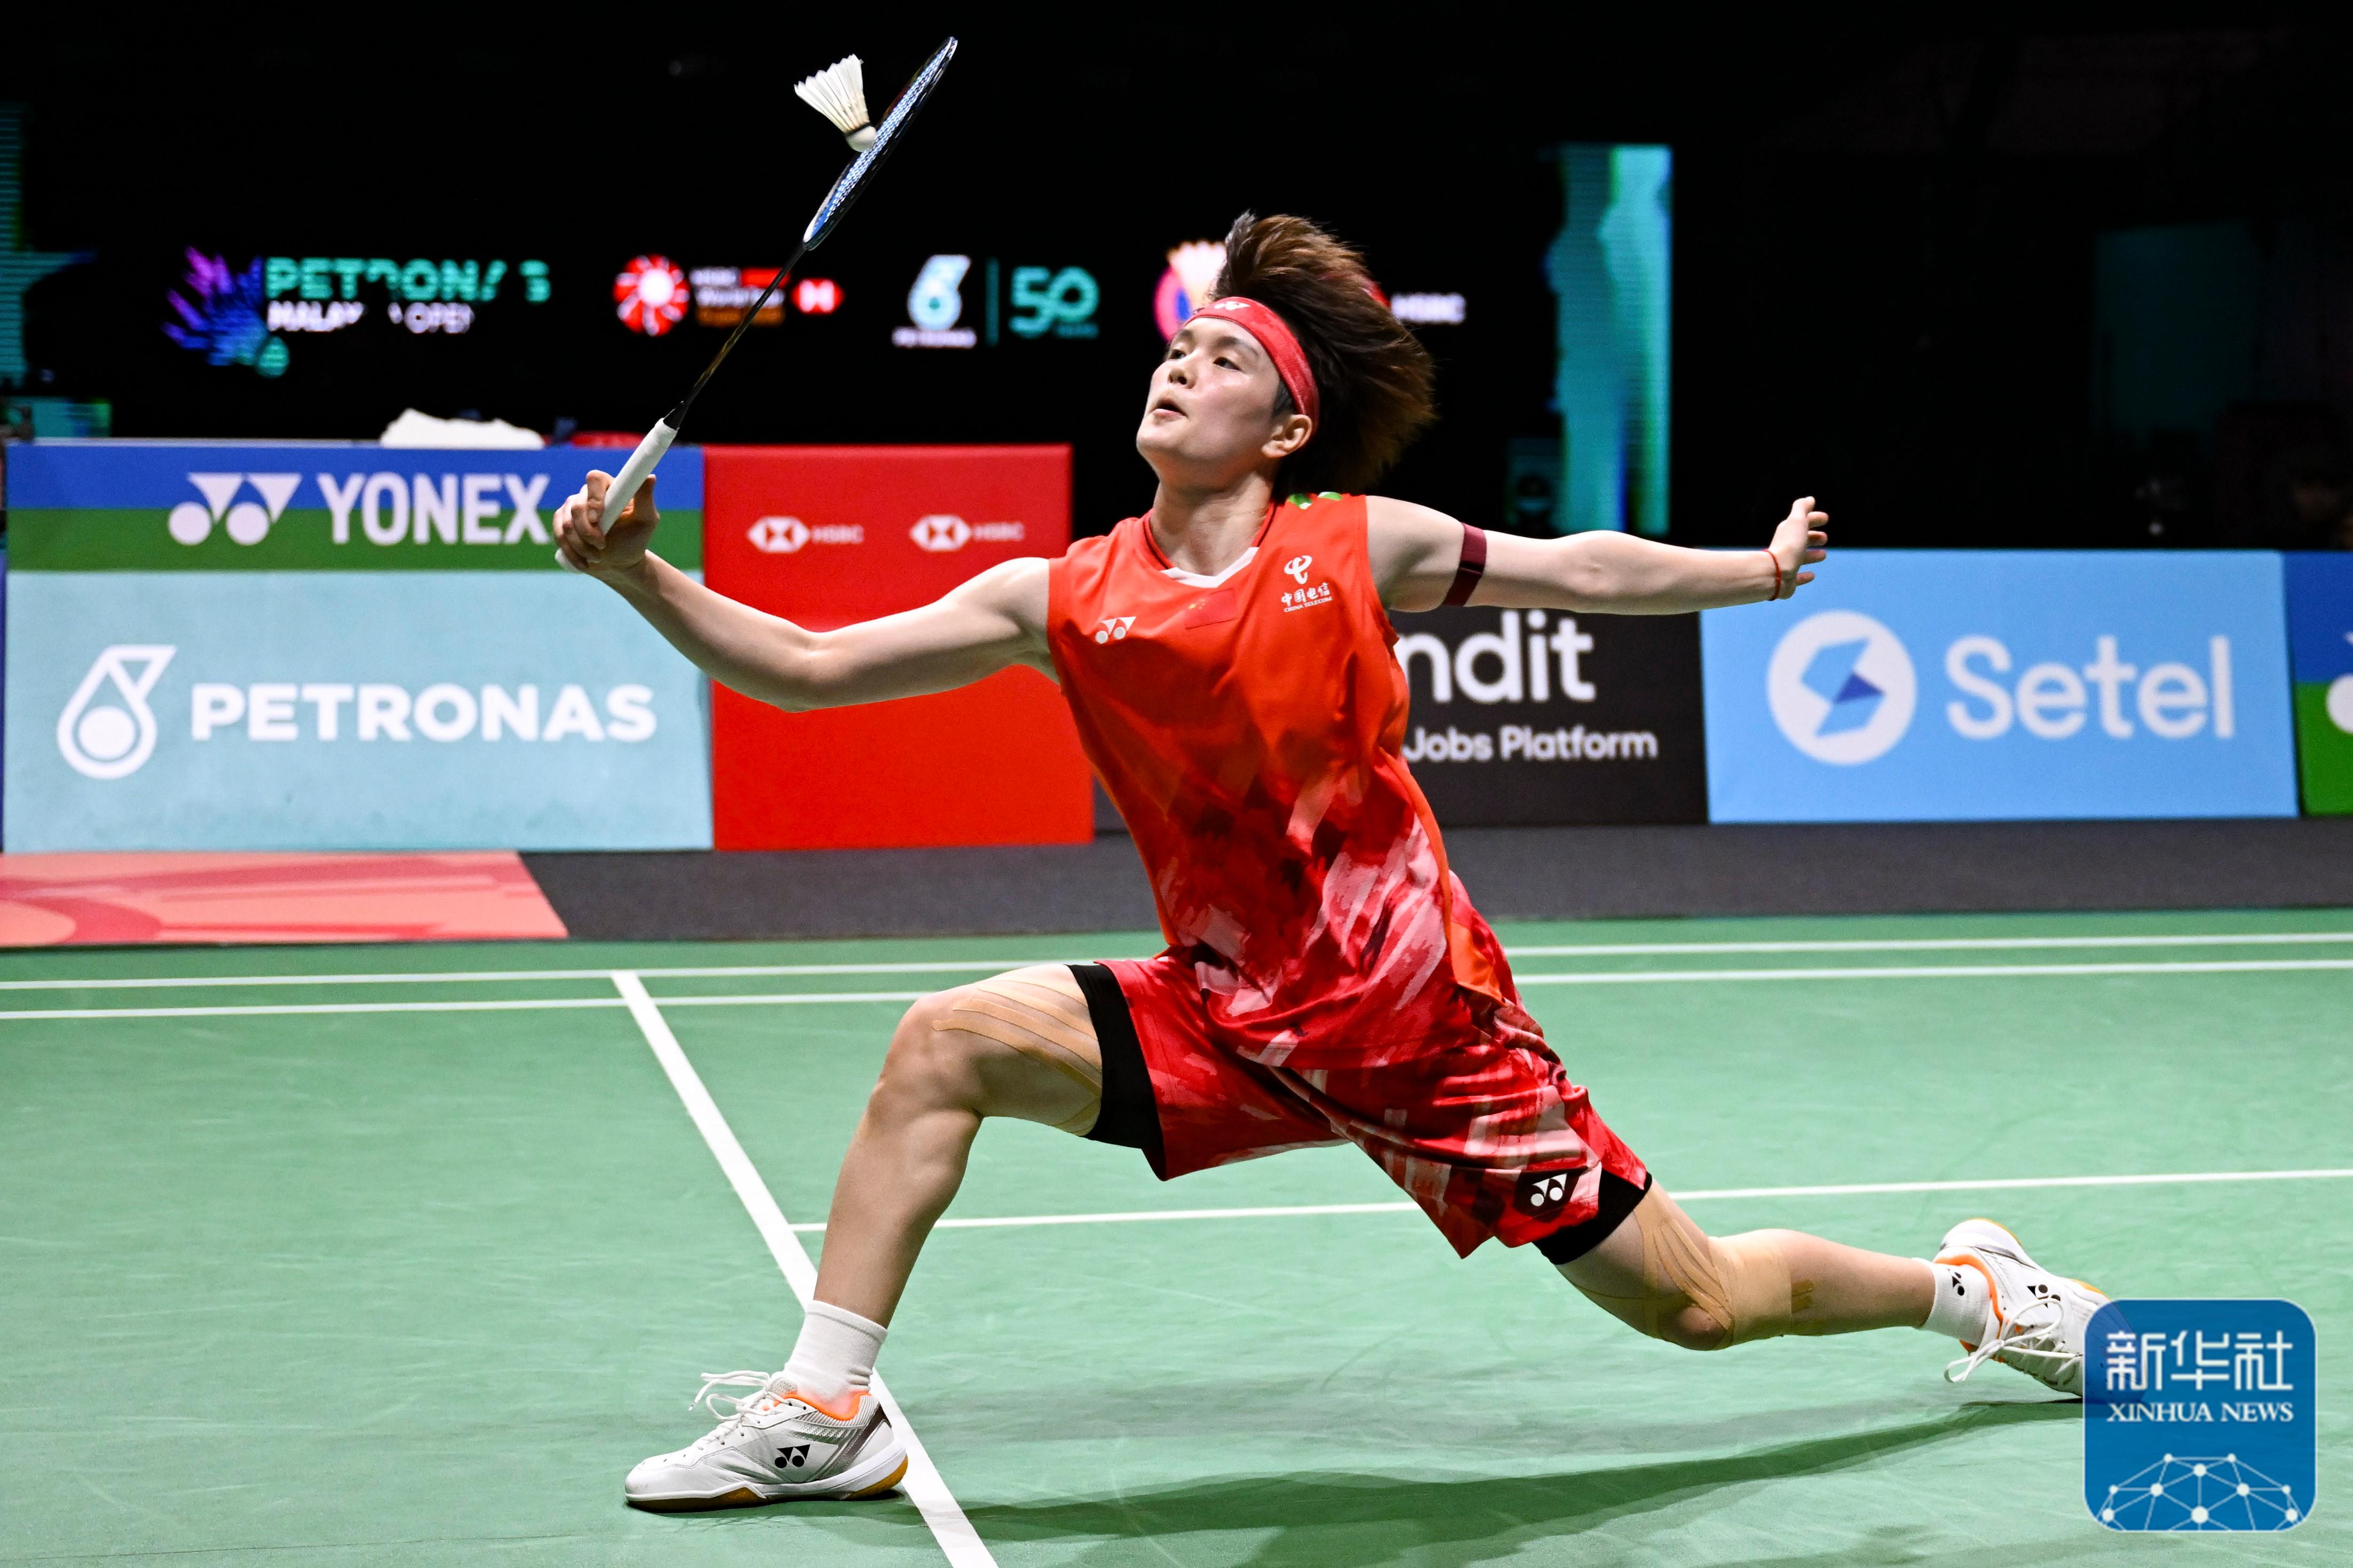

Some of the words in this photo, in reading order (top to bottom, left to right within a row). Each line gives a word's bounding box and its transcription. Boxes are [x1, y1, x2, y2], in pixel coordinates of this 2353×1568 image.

[318, 473, 551, 544] YONEX
[1281, 582, 1330, 607] 中国电信
[191, 683, 657, 742] PETRONAS
[1946, 635, 2234, 739] Setel
[1401, 726, 1493, 761] Jobs
[1500, 725, 1658, 760] Platform
